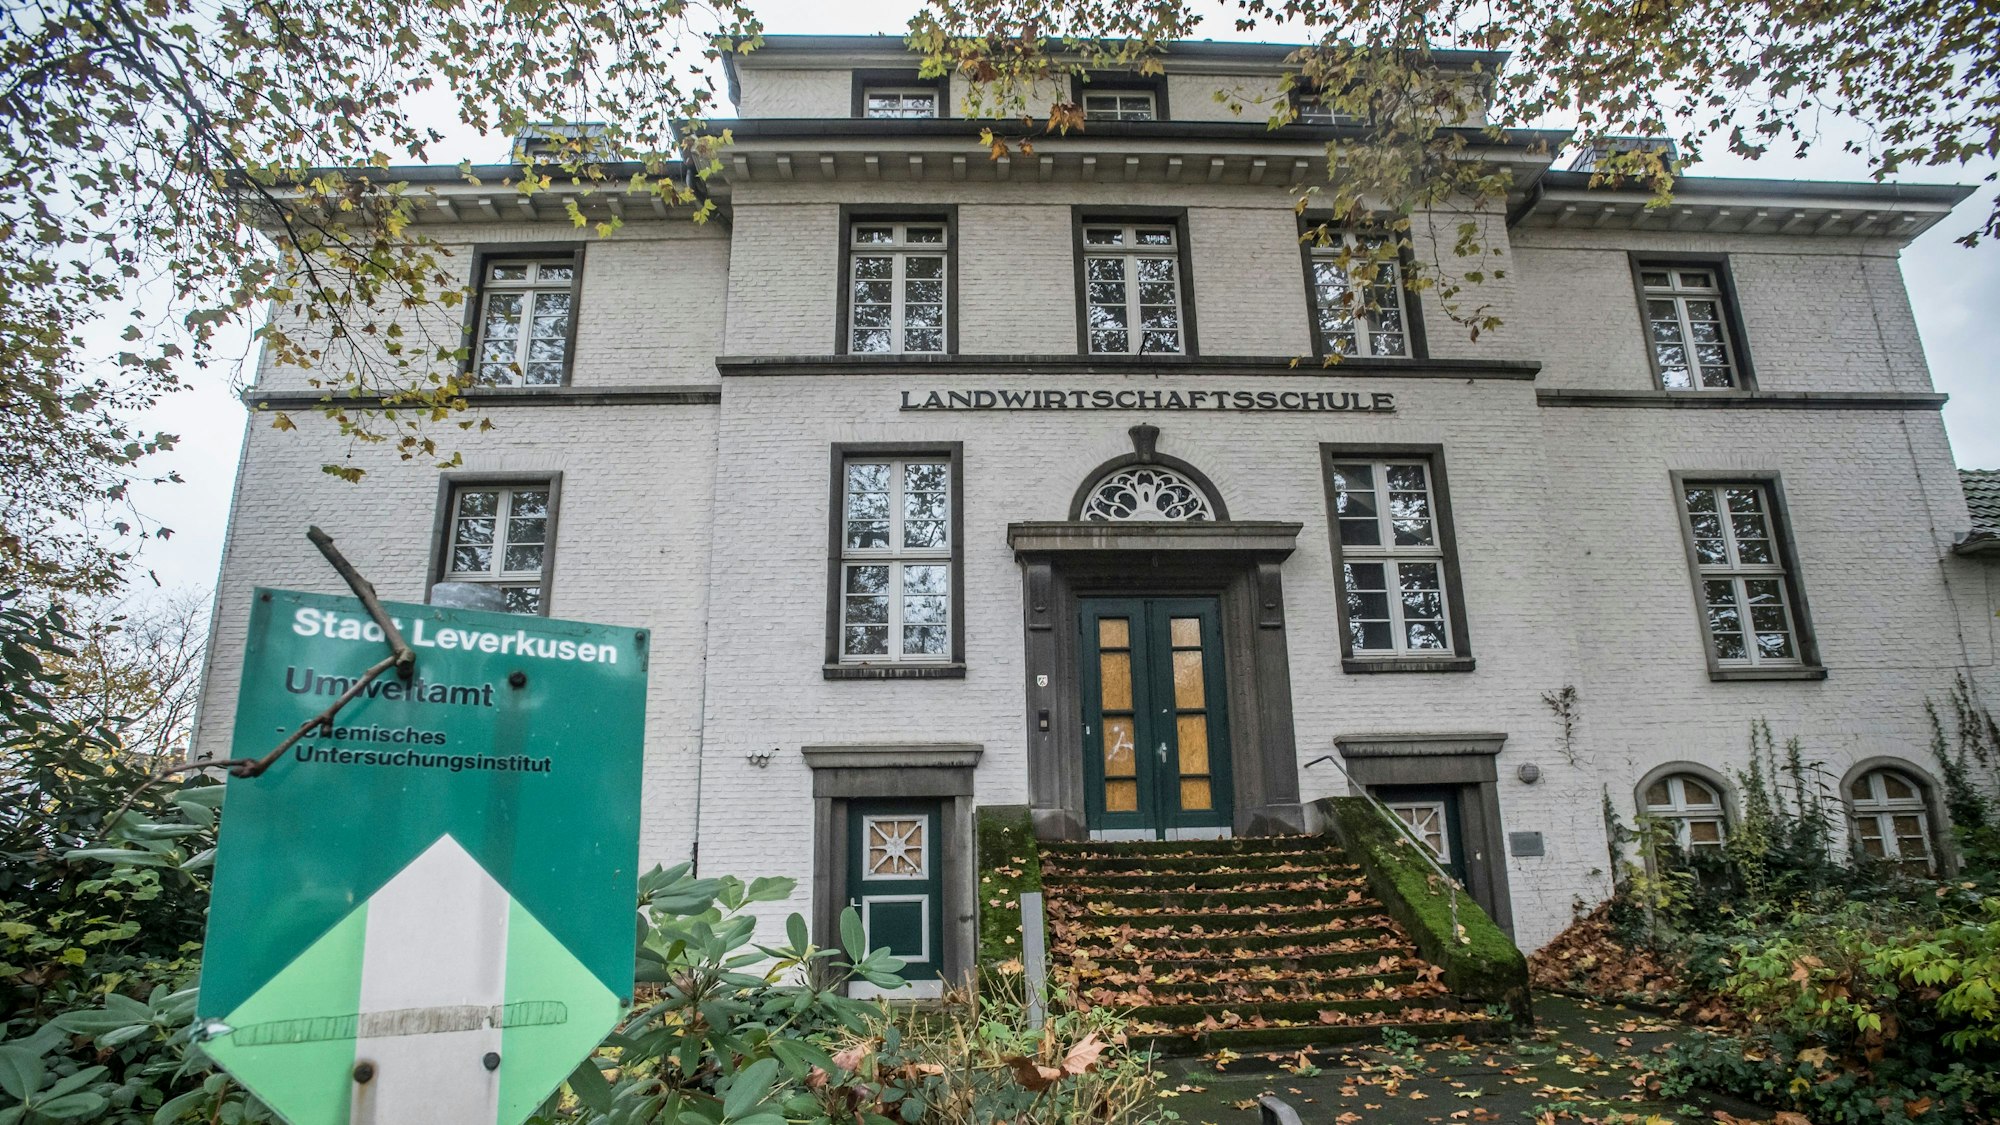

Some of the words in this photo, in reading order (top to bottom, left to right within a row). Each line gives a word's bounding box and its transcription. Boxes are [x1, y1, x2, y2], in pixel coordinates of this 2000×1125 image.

[900, 390, 1395, 410] LANDWIRTSCHAFTSSCHULE
[292, 607, 403, 643] Stad
[413, 619, 617, 664] Leverkusen
[295, 745, 551, 773] Untersuchungsinstitut
